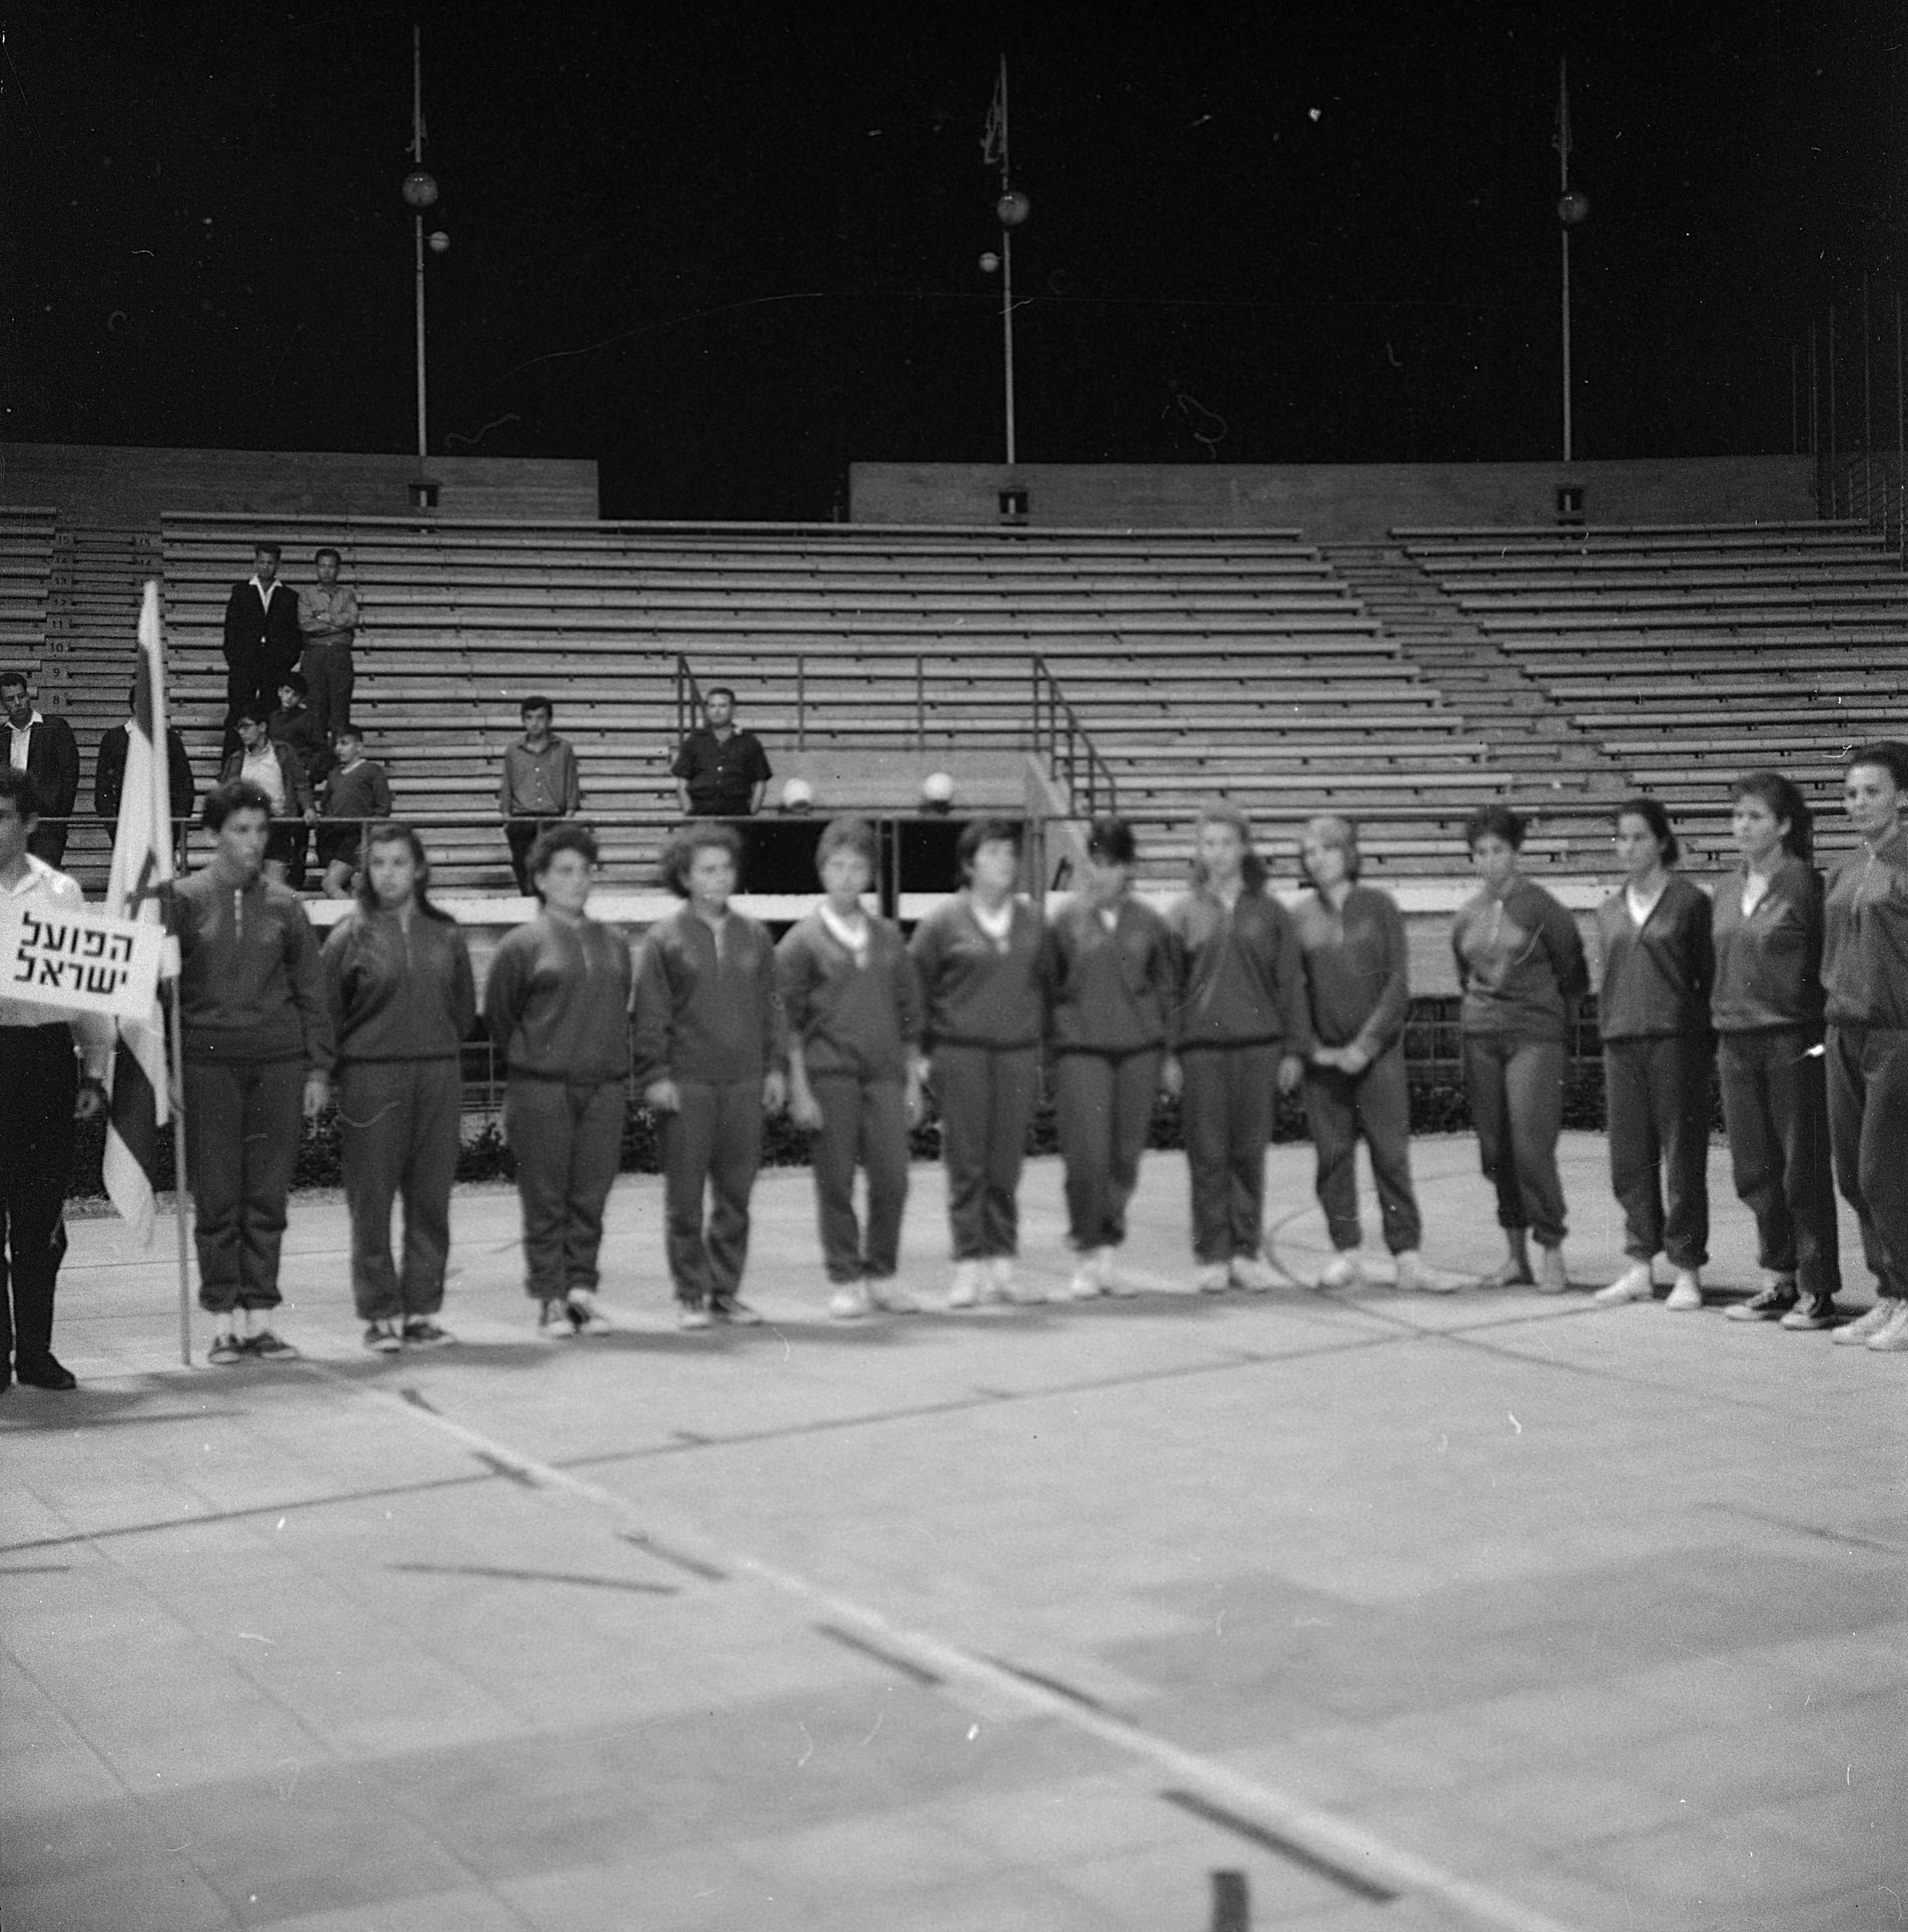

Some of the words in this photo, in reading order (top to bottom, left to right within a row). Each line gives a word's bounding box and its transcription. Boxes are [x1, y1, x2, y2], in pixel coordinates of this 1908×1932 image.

[51, 643, 63, 652] 10
[53, 668, 60, 677] 9
[53, 695, 60, 704] 8
[21, 911, 133, 961] הפועל
[14, 948, 127, 994] ישראל
